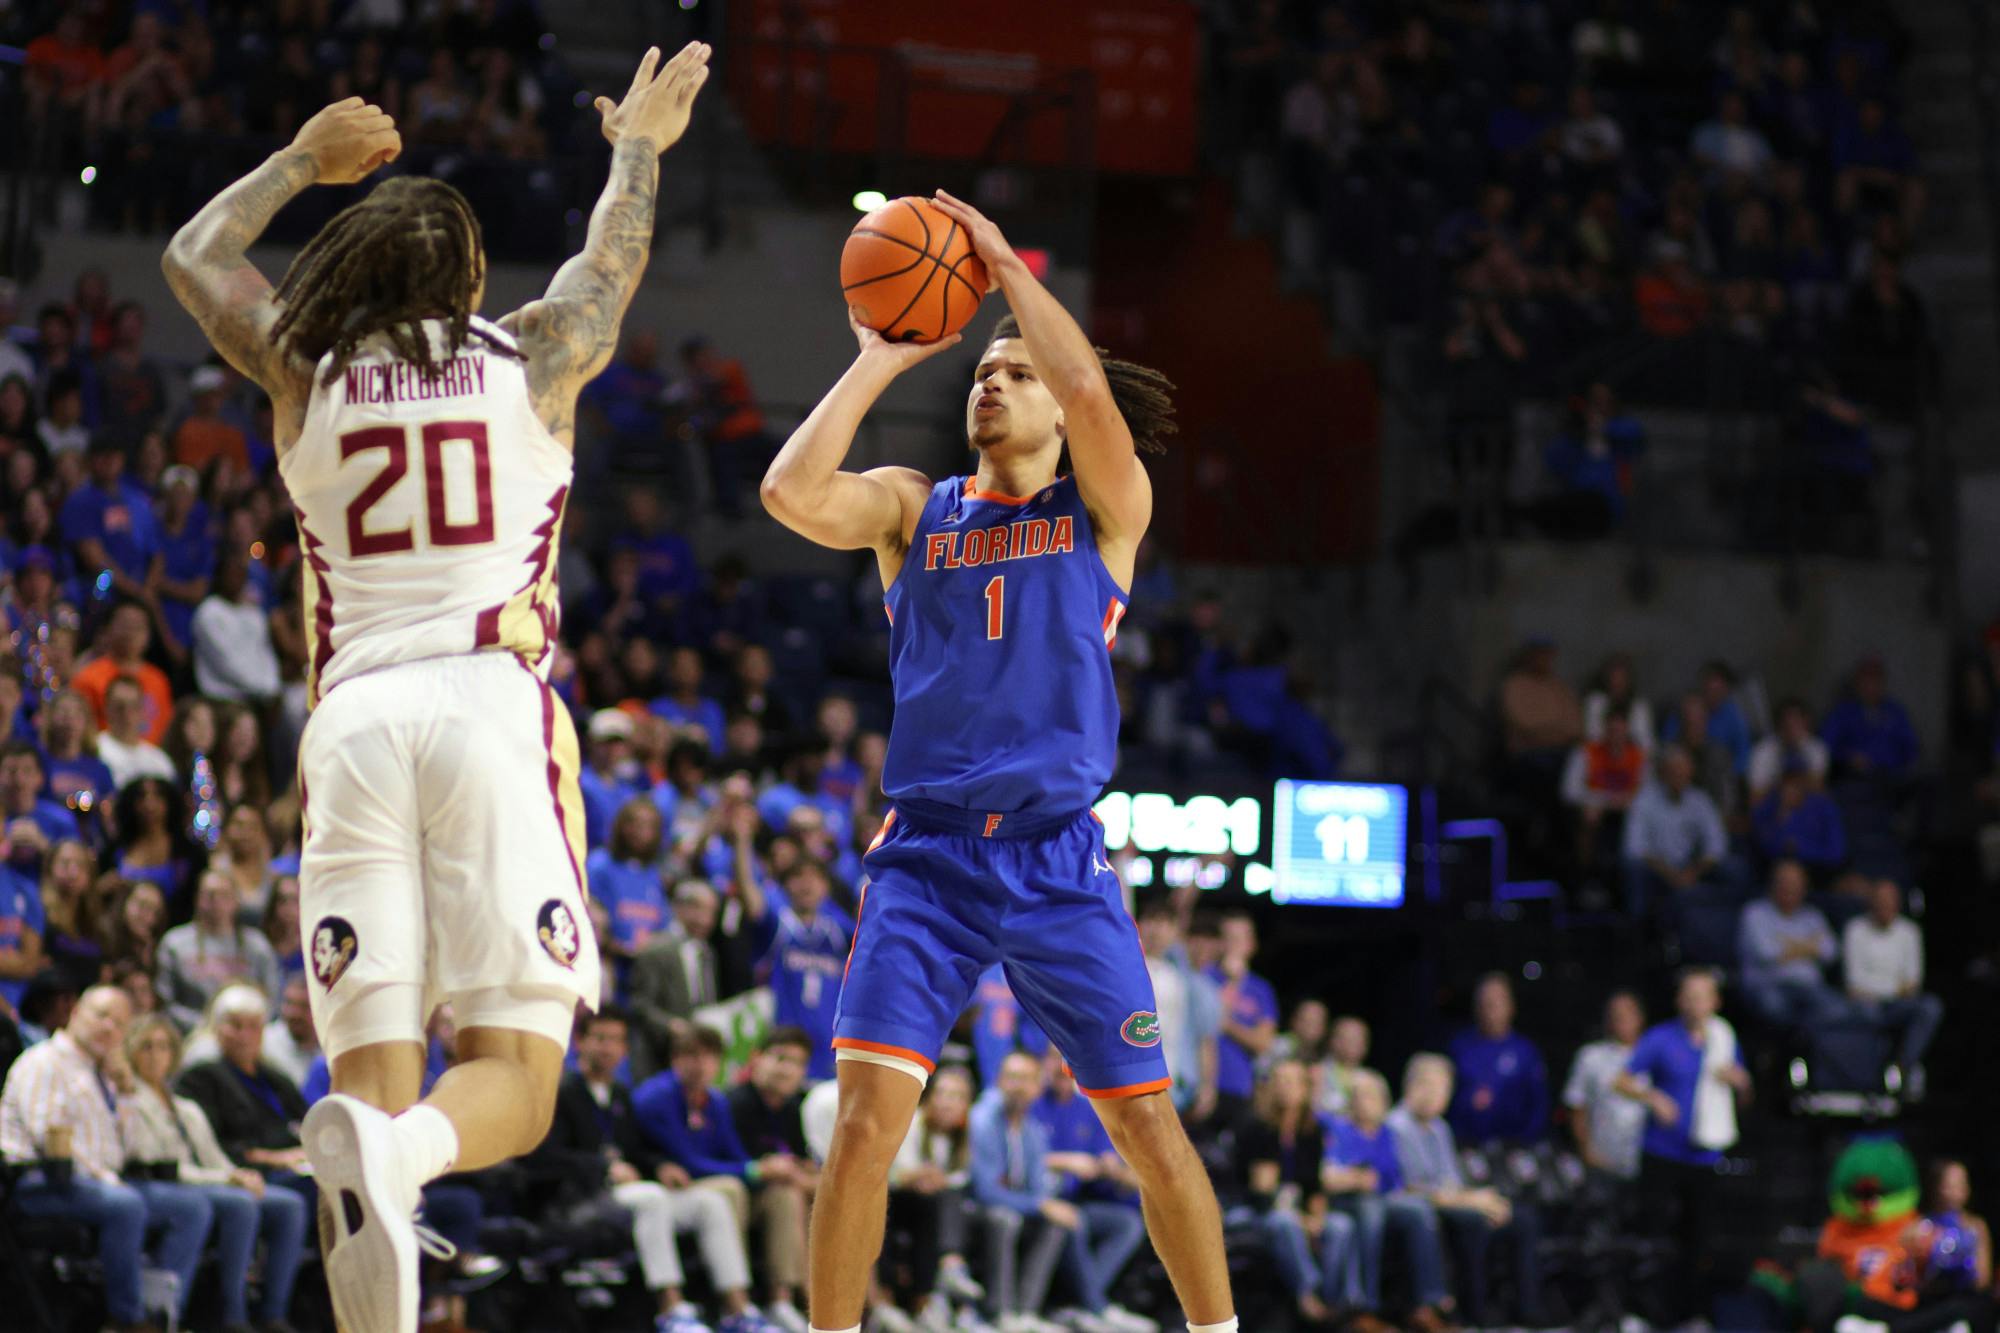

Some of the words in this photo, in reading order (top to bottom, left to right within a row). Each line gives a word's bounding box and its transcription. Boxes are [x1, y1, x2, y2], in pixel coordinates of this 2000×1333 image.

[345, 355, 485, 405] NICKELBERRY
[337, 418, 496, 558] 20
[924, 515, 1074, 571] FLORIDA
[984, 575, 1005, 641] 1
[982, 814, 1003, 837] F
[1314, 813, 1370, 865] 11
